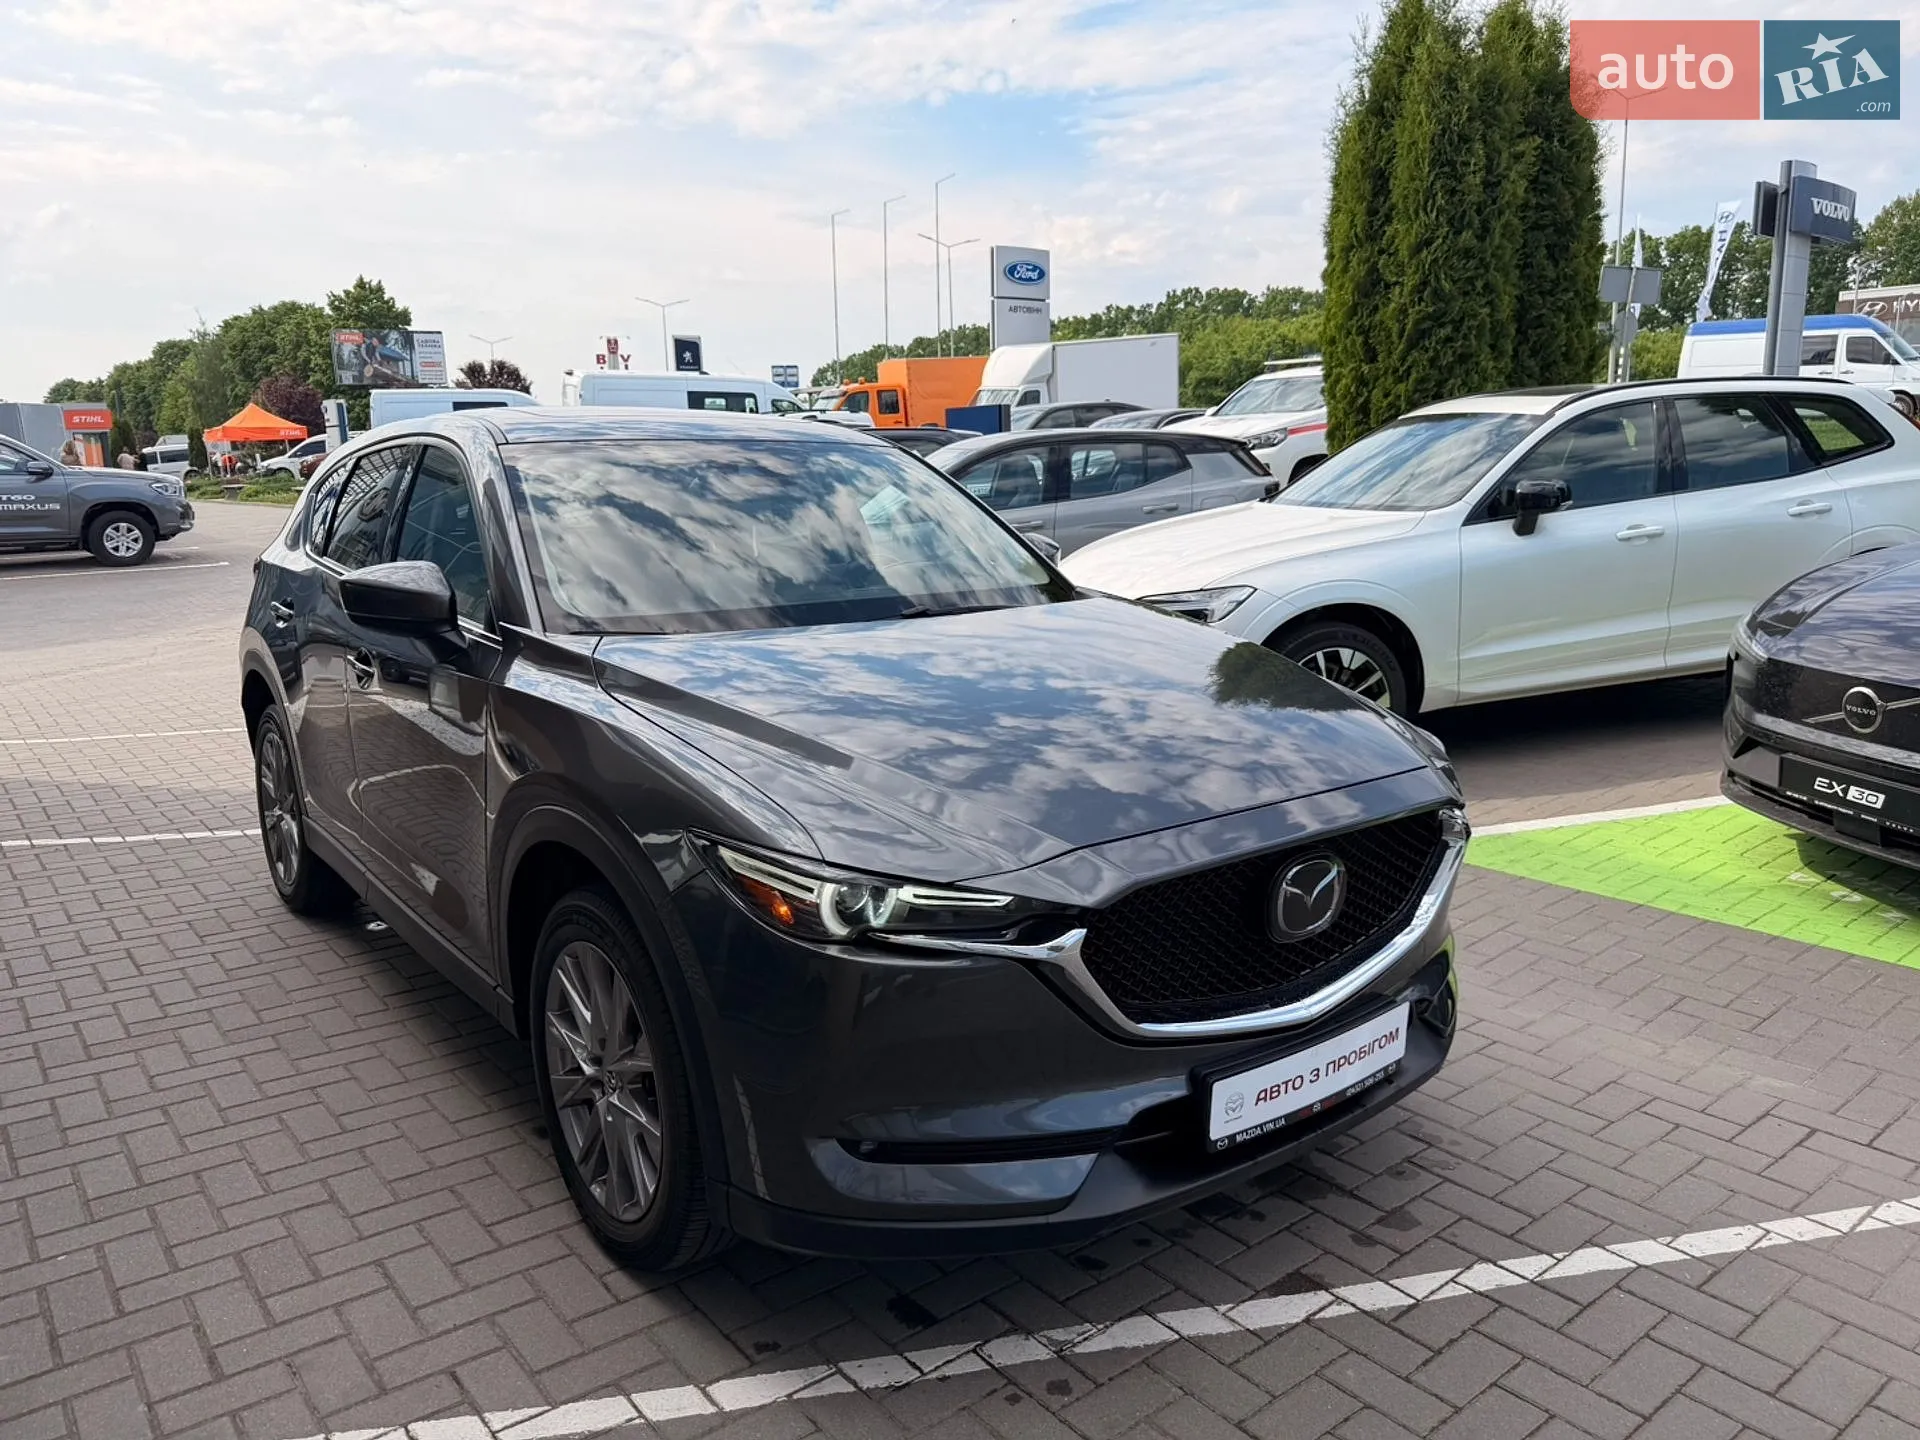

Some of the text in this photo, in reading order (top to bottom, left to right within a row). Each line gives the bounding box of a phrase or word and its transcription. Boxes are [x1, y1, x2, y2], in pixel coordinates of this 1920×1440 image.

[1810, 197, 1850, 222] VOLVO
[1014, 263, 1040, 280] Ford
[71, 415, 105, 423] STIHL
[1845, 704, 1877, 716] VOLVO
[1254, 1075, 1304, 1106] АВТО
[1309, 1068, 1320, 1083] З
[1325, 1027, 1400, 1077] ПРОБІГОМ
